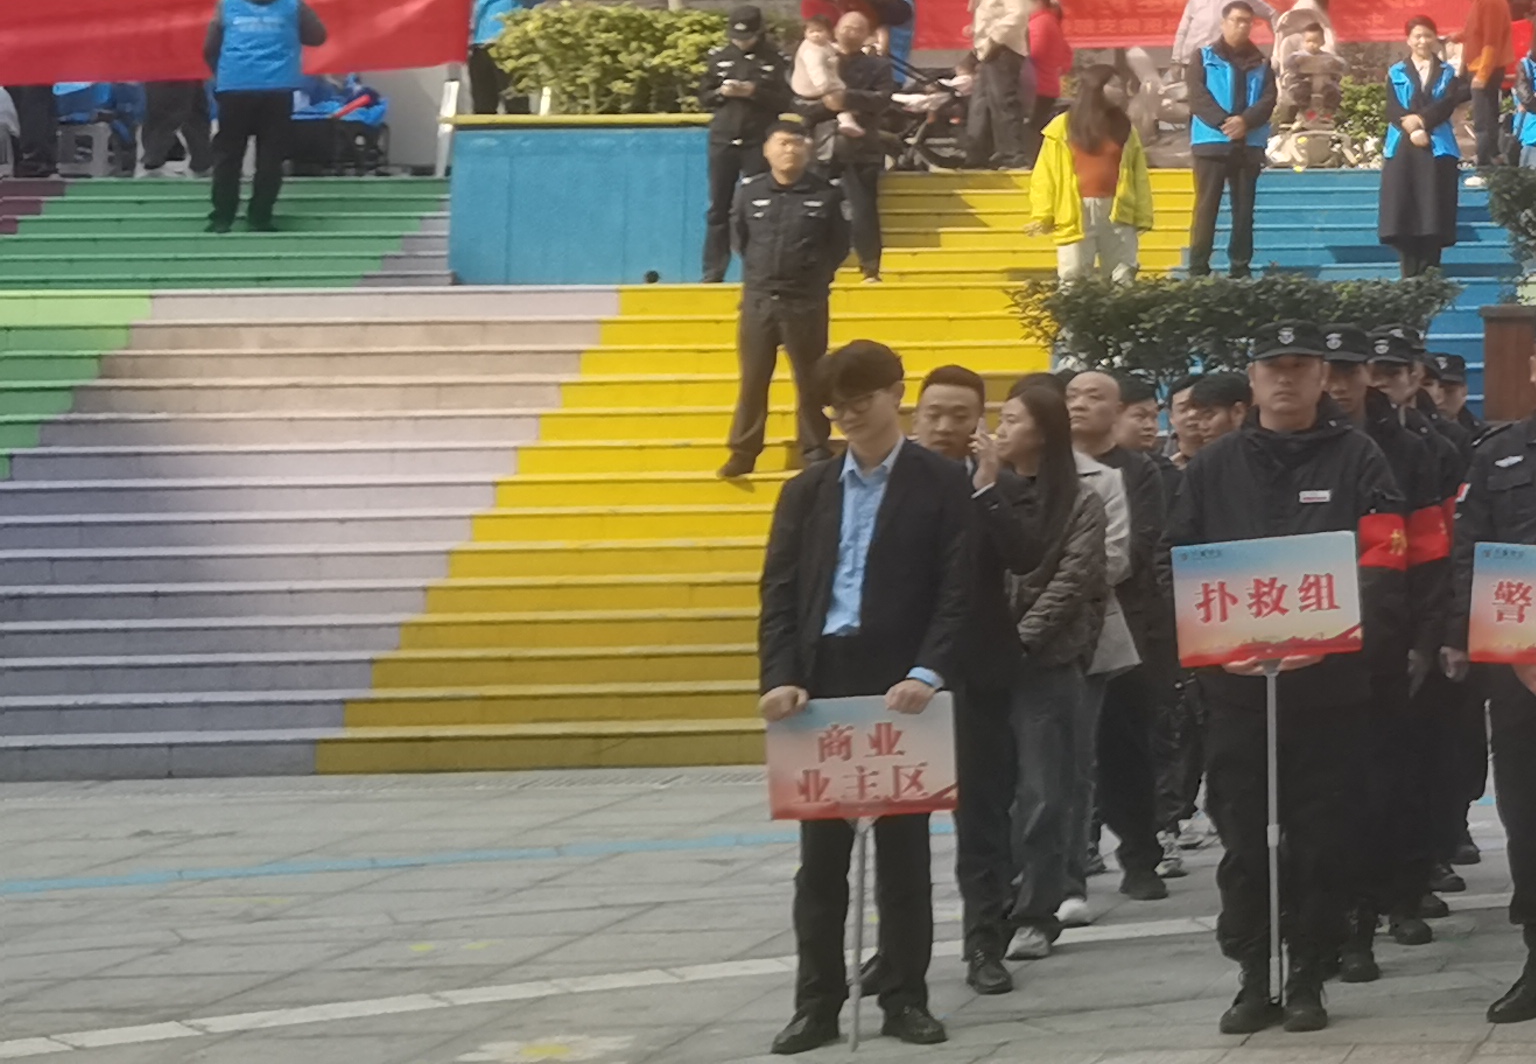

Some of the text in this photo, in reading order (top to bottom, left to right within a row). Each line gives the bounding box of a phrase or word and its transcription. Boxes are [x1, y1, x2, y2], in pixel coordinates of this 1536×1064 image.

[1195, 572, 1341, 623] 扑救组
[818, 723, 905, 762] 商业
[796, 762, 928, 802] 业主区
